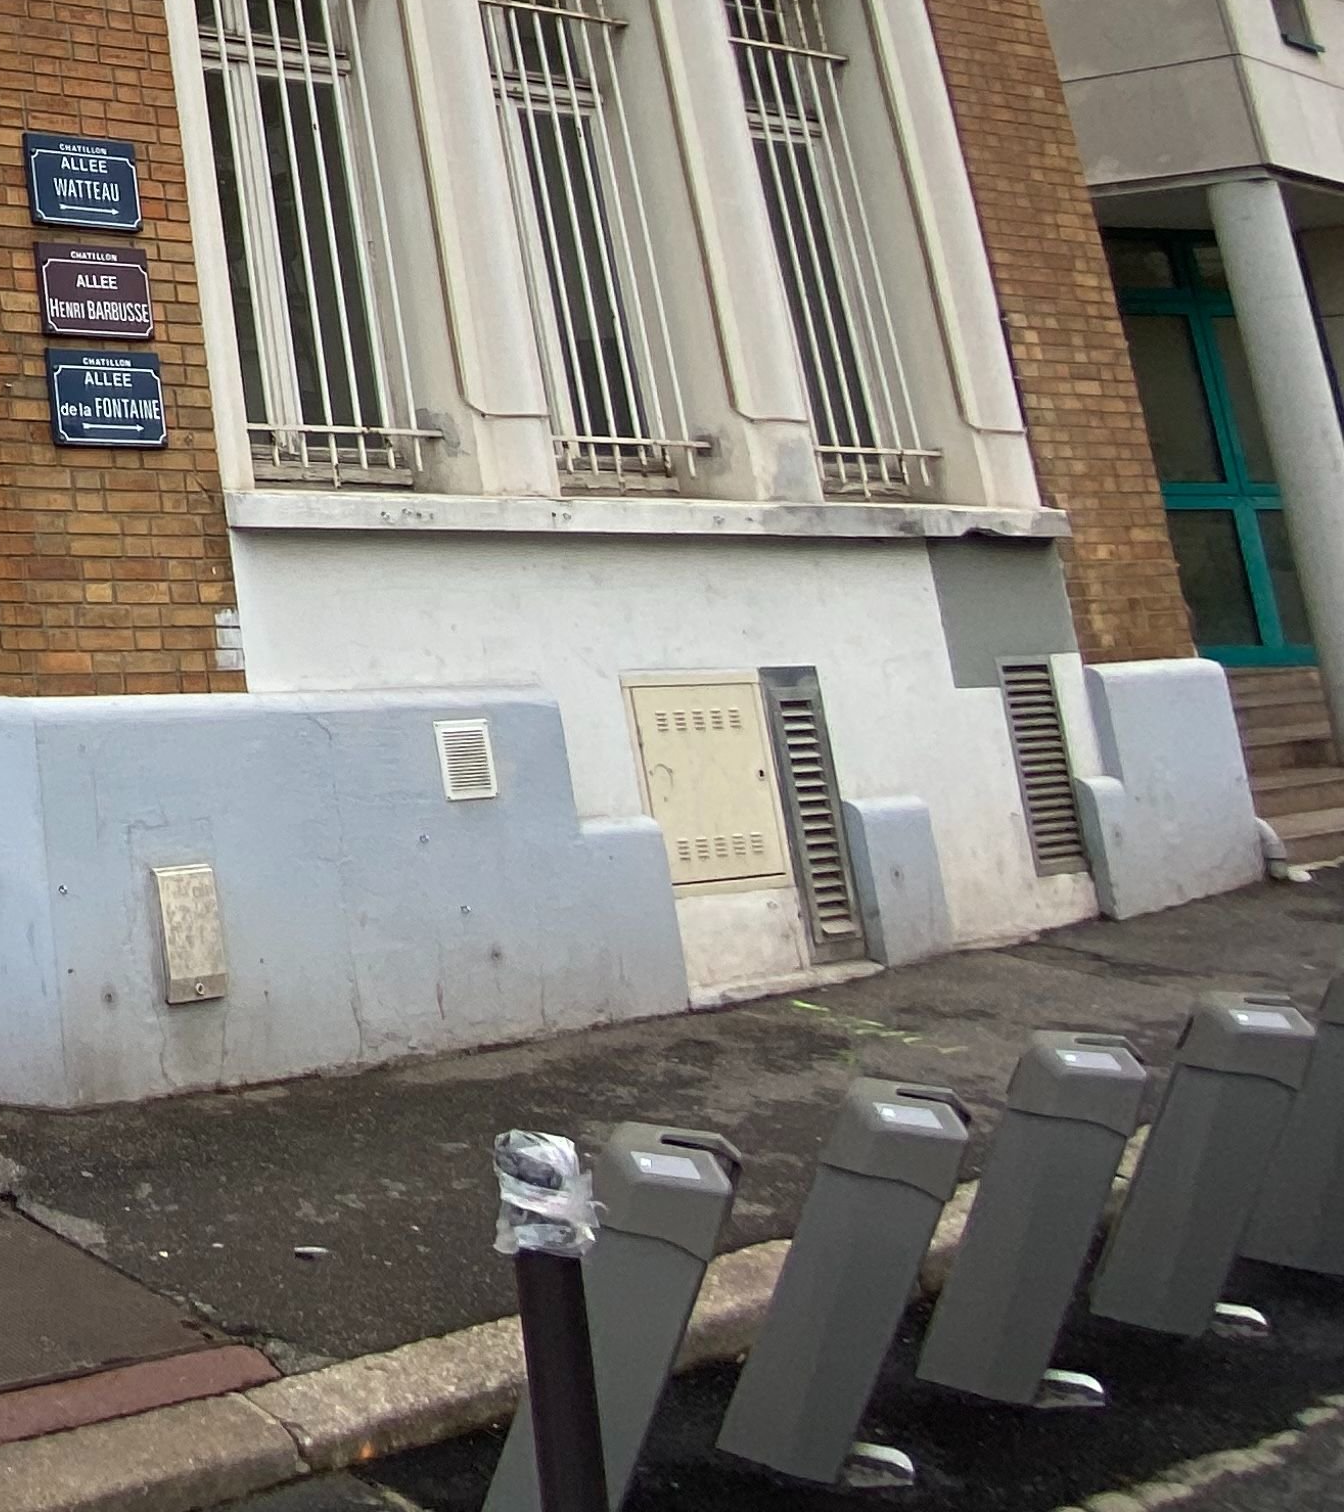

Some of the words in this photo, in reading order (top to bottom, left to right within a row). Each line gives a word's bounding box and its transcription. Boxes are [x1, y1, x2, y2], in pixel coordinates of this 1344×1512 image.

[59, 143, 108, 155] CHATILLON
[60, 156, 108, 174] ALLEE
[53, 177, 120, 202] WATTEAU
[70, 251, 118, 262] CHATILLON
[76, 274, 119, 290] ALLEE
[49, 298, 86, 319] HENRI
[86, 300, 150, 323] BARBUSSE
[82, 357, 132, 367] CHATILLON
[84, 371, 133, 387] ALLEE
[60, 402, 78, 416] de
[78, 402, 92, 417] la
[94, 397, 161, 420] FONTAINE
